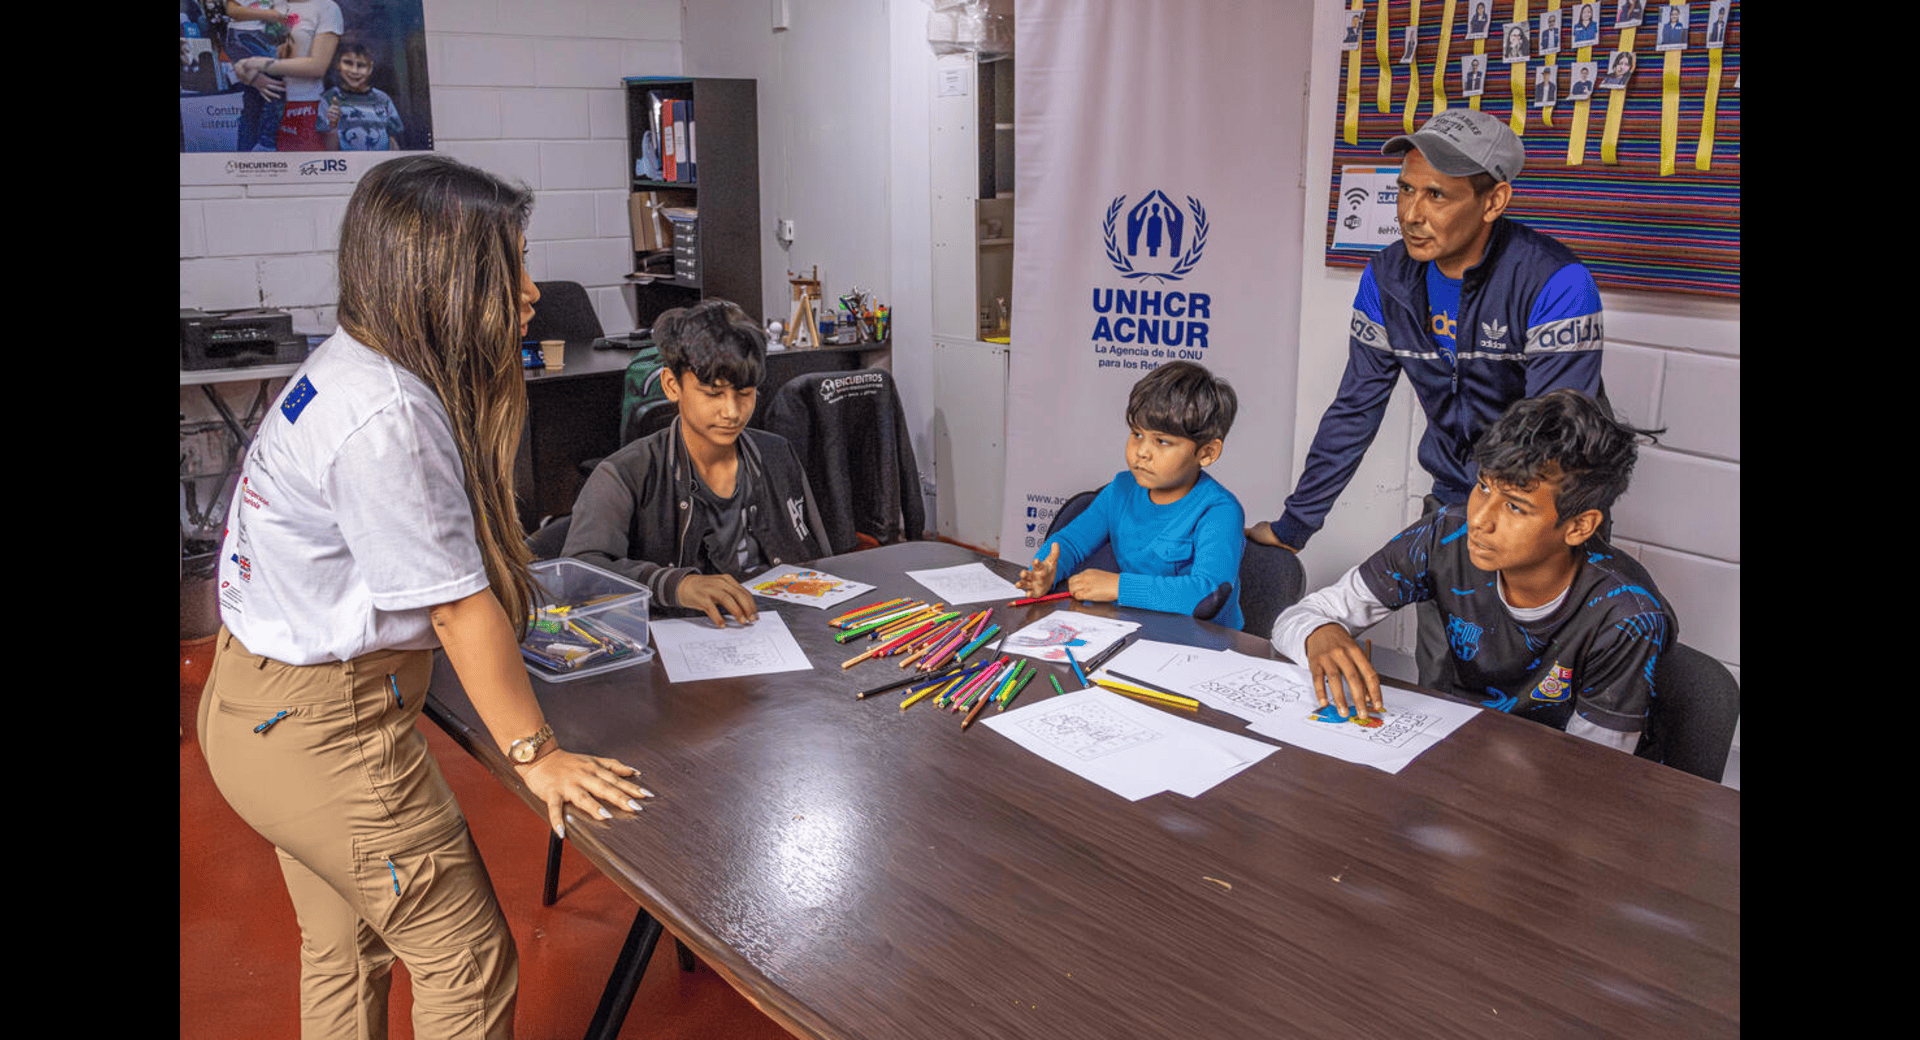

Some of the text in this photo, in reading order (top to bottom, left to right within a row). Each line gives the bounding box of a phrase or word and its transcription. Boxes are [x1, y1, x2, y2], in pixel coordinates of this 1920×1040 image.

[238, 161, 288, 169] ENCUENTROS
[319, 159, 347, 172] JRS
[1092, 288, 1211, 319] UNHCR
[1091, 316, 1209, 348] ACNUR
[1480, 339, 1507, 350] adidas
[1095, 344, 1203, 361] La Agencia de la ONU
[1098, 359, 1121, 370] para
[1123, 359, 1138, 369] los
[834, 374, 883, 388] ENCUENTROS
